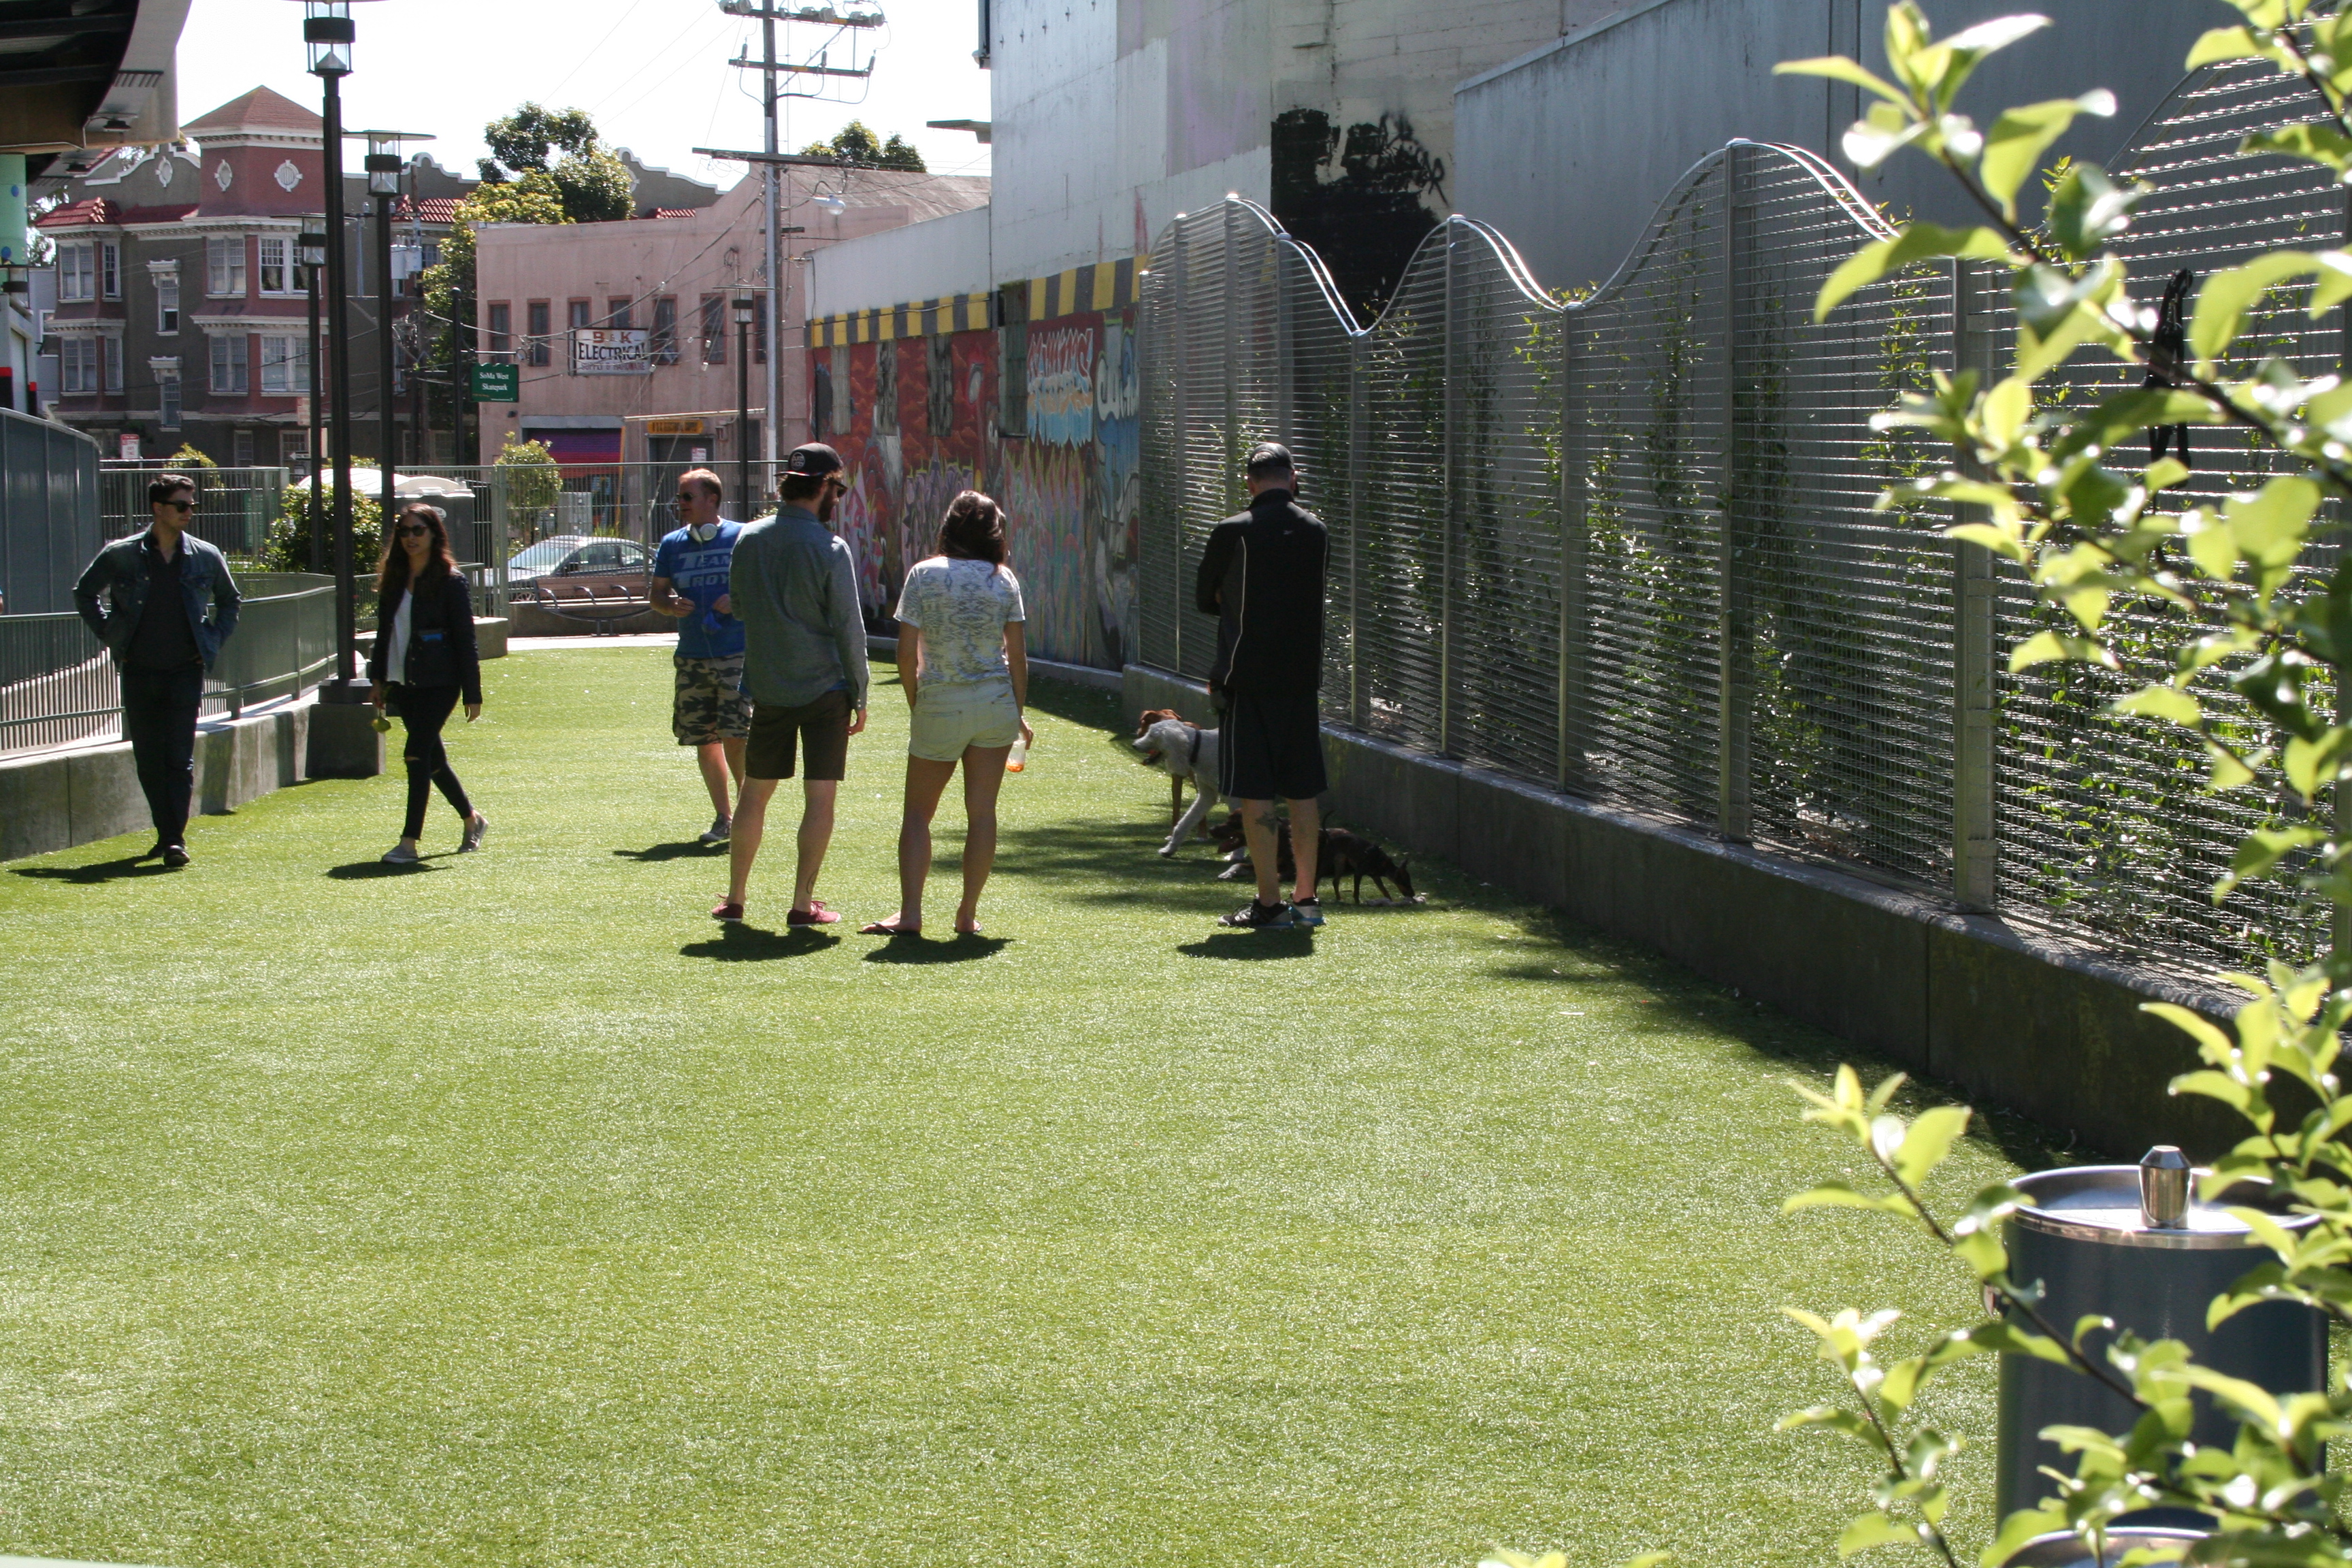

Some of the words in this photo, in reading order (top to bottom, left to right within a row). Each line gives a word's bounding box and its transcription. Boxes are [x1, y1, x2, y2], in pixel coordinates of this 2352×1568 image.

[593, 331, 605, 344] B
[621, 331, 633, 344] K
[578, 342, 649, 362] ELECTRICAL
[482, 382, 508, 392] Skatepark
